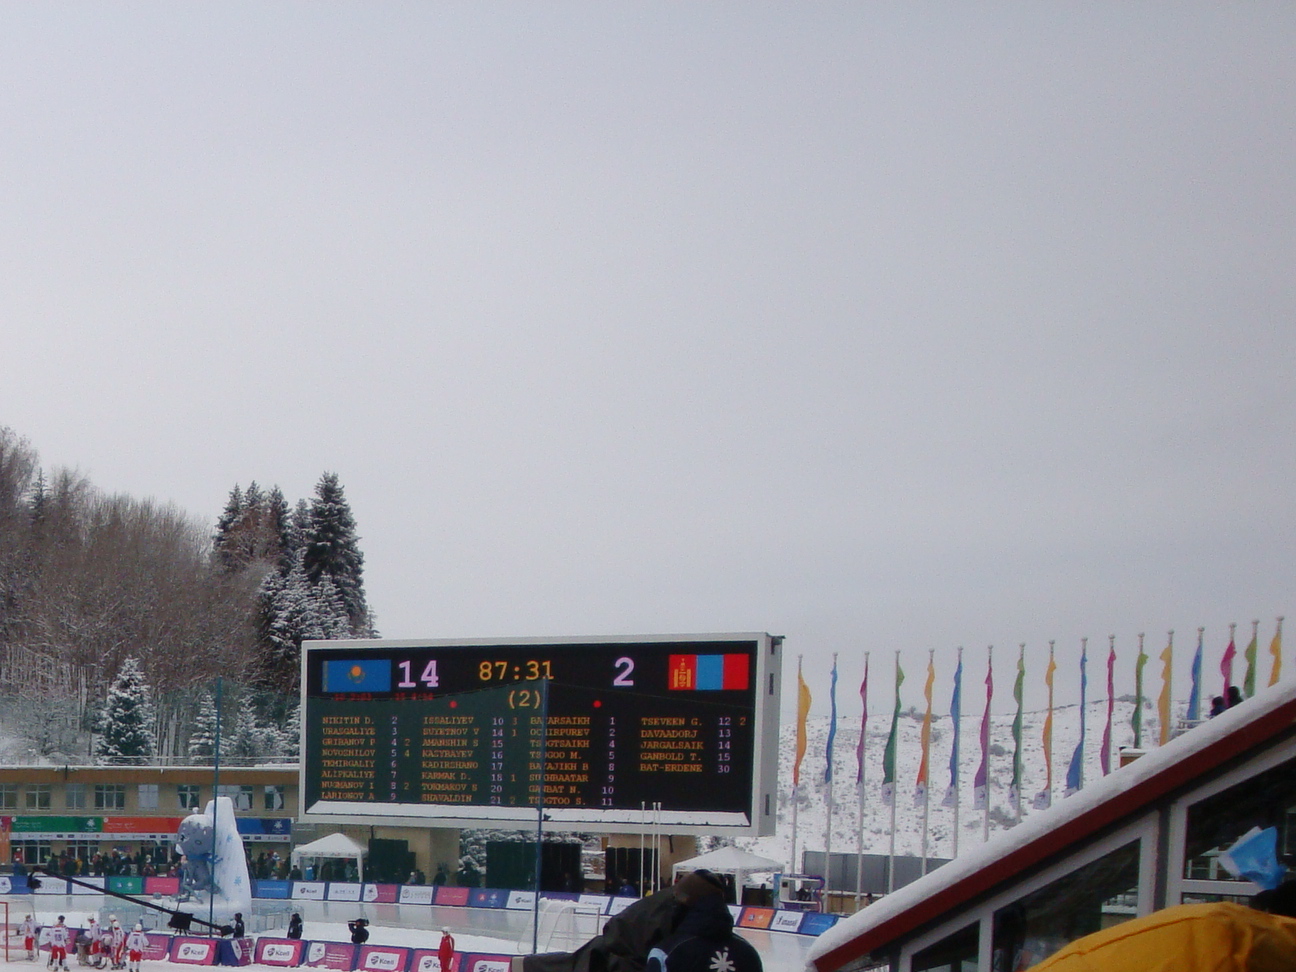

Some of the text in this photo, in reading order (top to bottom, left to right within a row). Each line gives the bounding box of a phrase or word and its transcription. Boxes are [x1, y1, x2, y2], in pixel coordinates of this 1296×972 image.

[398, 660, 439, 688] 14
[479, 661, 554, 681] 87:31
[613, 657, 635, 687] 2
[509, 690, 541, 709] (2)
[322, 716, 360, 724] NIKITIN
[641, 717, 746, 726] TSEVEEN G. 12 2
[392, 727, 398, 735] 3
[641, 730, 698, 738] DAVAADORJ
[391, 738, 397, 746] 4
[404, 738, 410, 746] 2
[609, 740, 615, 748] 4
[641, 741, 731, 749] JARGALSAIK 14
[391, 749, 397, 757] 5
[404, 749, 410, 757] 4
[492, 751, 503, 759] 16
[529, 751, 565, 759] TSGOO
[690, 753, 701, 761] T.
[718, 753, 730, 761] 15
[391, 760, 396, 768] 6
[492, 762, 503, 770] 17
[529, 762, 577, 770] BAAJIKH
[609, 763, 614, 771] 8
[640, 764, 730, 773] BAT-ERDENE 30
[404, 782, 410, 790] 2
[570, 786, 580, 794] N.
[602, 786, 614, 794] 10
[490, 796, 501, 804] 21
[509, 796, 515, 804] 2
[529, 796, 612, 806] TSGTOO S. 11
